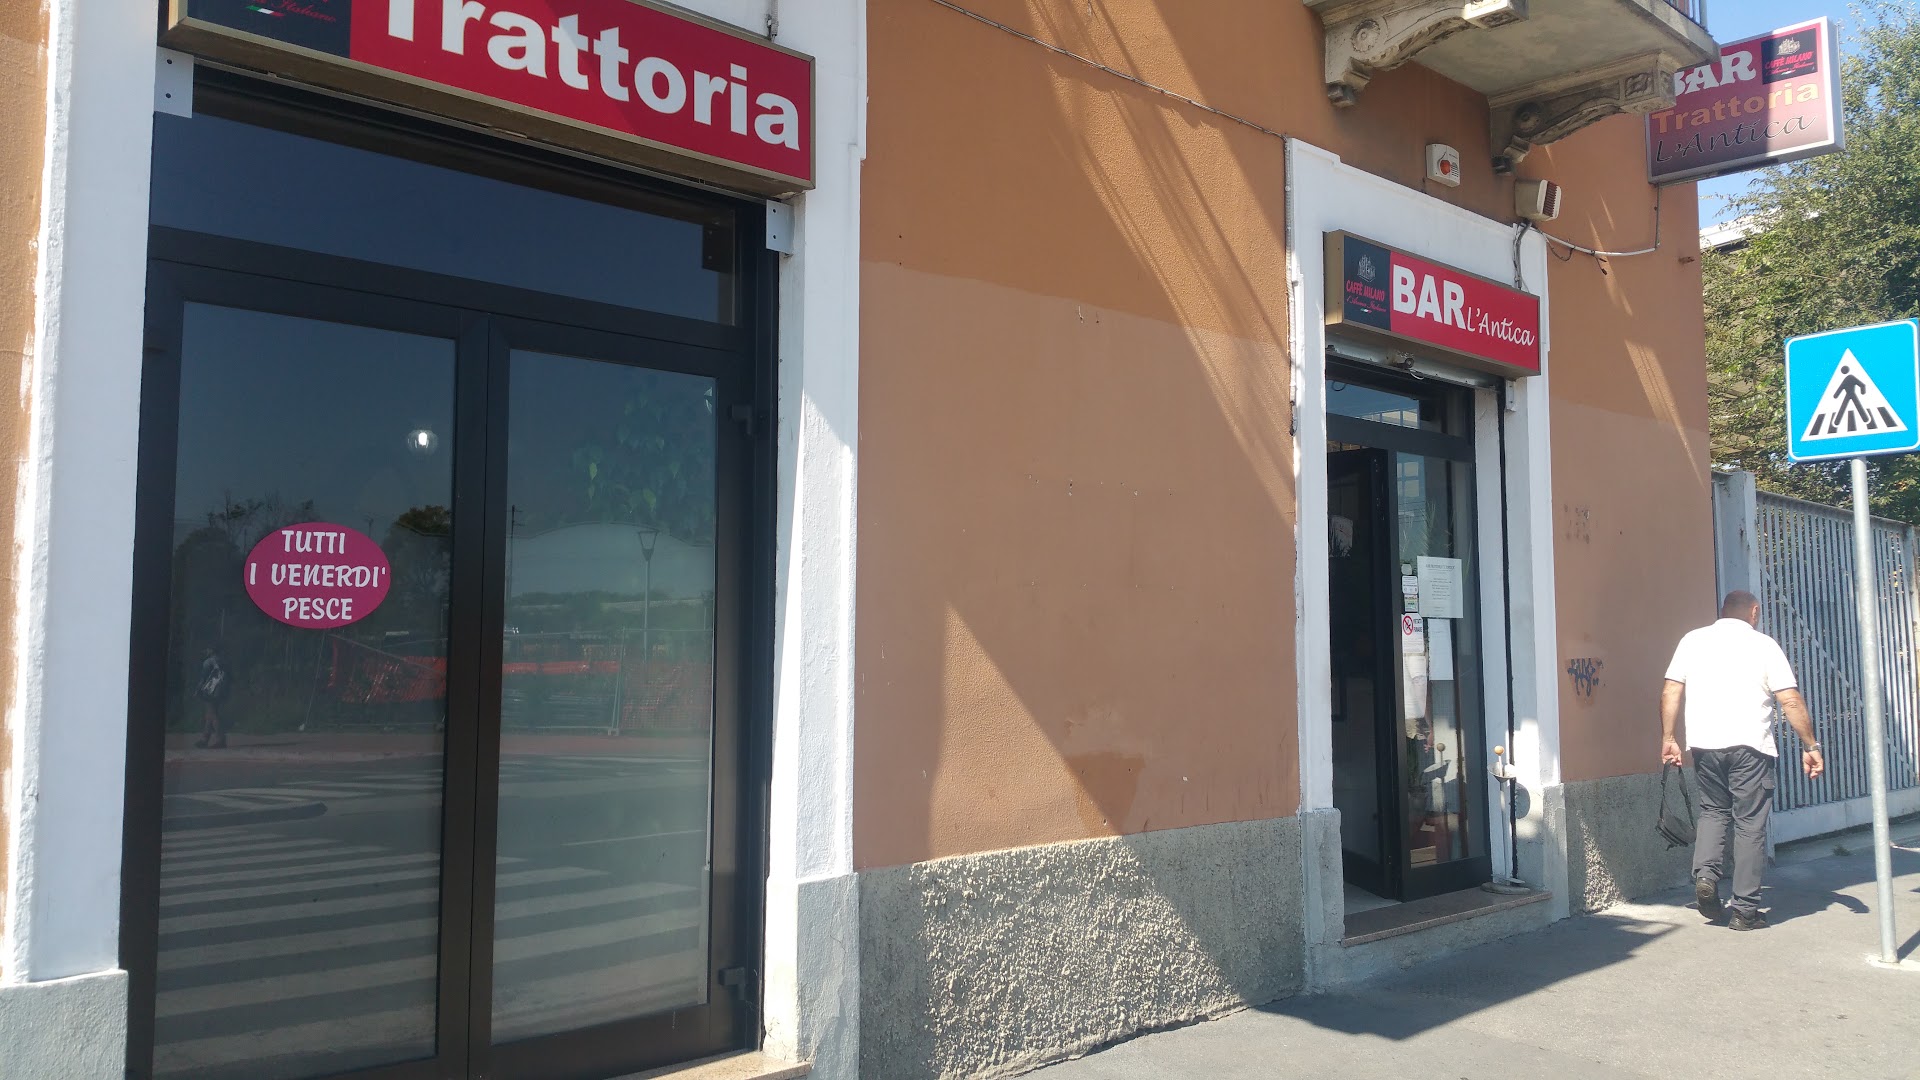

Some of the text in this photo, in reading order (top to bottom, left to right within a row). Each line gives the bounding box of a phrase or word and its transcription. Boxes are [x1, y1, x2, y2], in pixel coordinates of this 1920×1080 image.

[1651, 82, 1820, 135] Trattoria
[1656, 115, 1817, 162] L'Antica
[1363, 285, 1386, 302] MILANO
[1393, 264, 1535, 347] BAR L'Antica
[281, 529, 346, 555] TUTTI
[249, 562, 387, 588] I VENERDI'
[282, 596, 353, 621] PESCE
